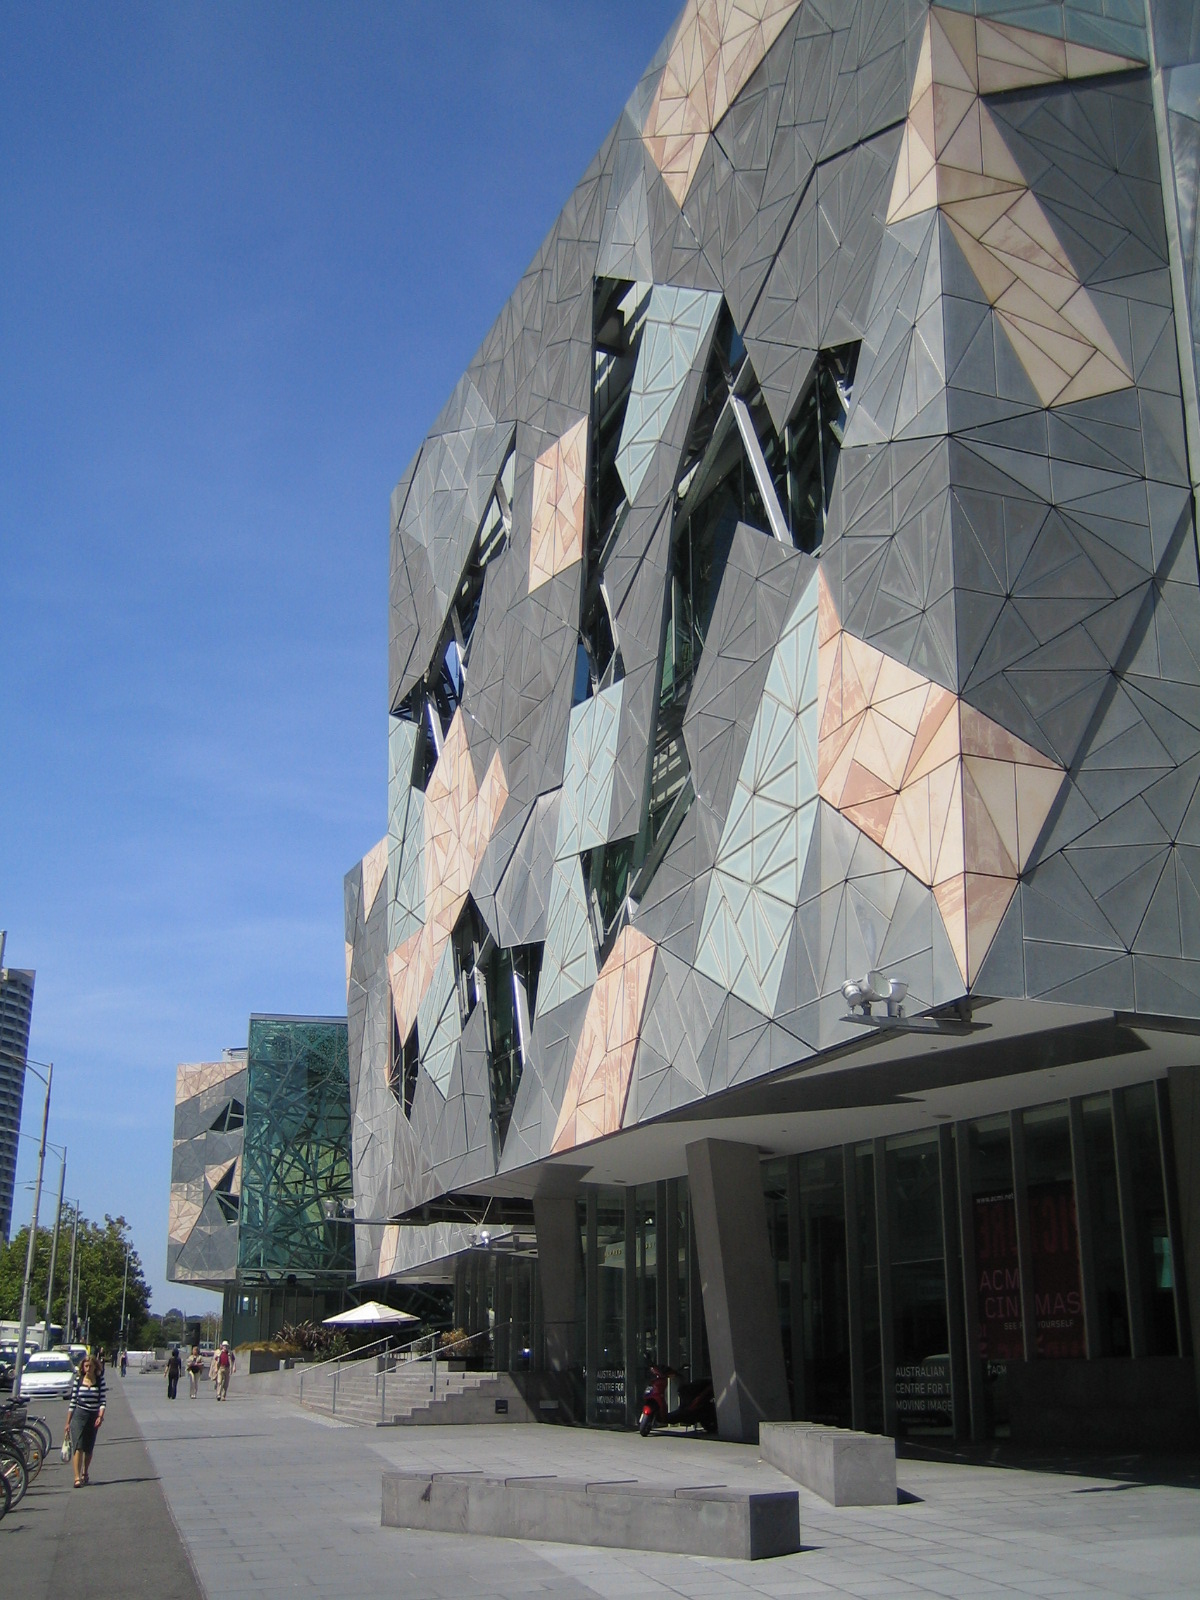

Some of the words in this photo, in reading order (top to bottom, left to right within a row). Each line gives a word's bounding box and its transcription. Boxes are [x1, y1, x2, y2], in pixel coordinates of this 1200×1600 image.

[979, 1268, 1021, 1292] ACM
[984, 1291, 1082, 1319] CINMAS
[1003, 1321, 1017, 1330] SEE
[895, 1366, 945, 1377] AUSTRALIAN
[596, 1382, 615, 1391] CENTRE
[615, 1382, 625, 1391] FOR
[895, 1383, 925, 1394] CENTRE
[927, 1383, 944, 1394] FOR
[596, 1395, 614, 1404] MOVING
[615, 1395, 627, 1405] IMAG
[895, 1399, 925, 1411] MOVING
[927, 1400, 953, 1411] IMAGE
